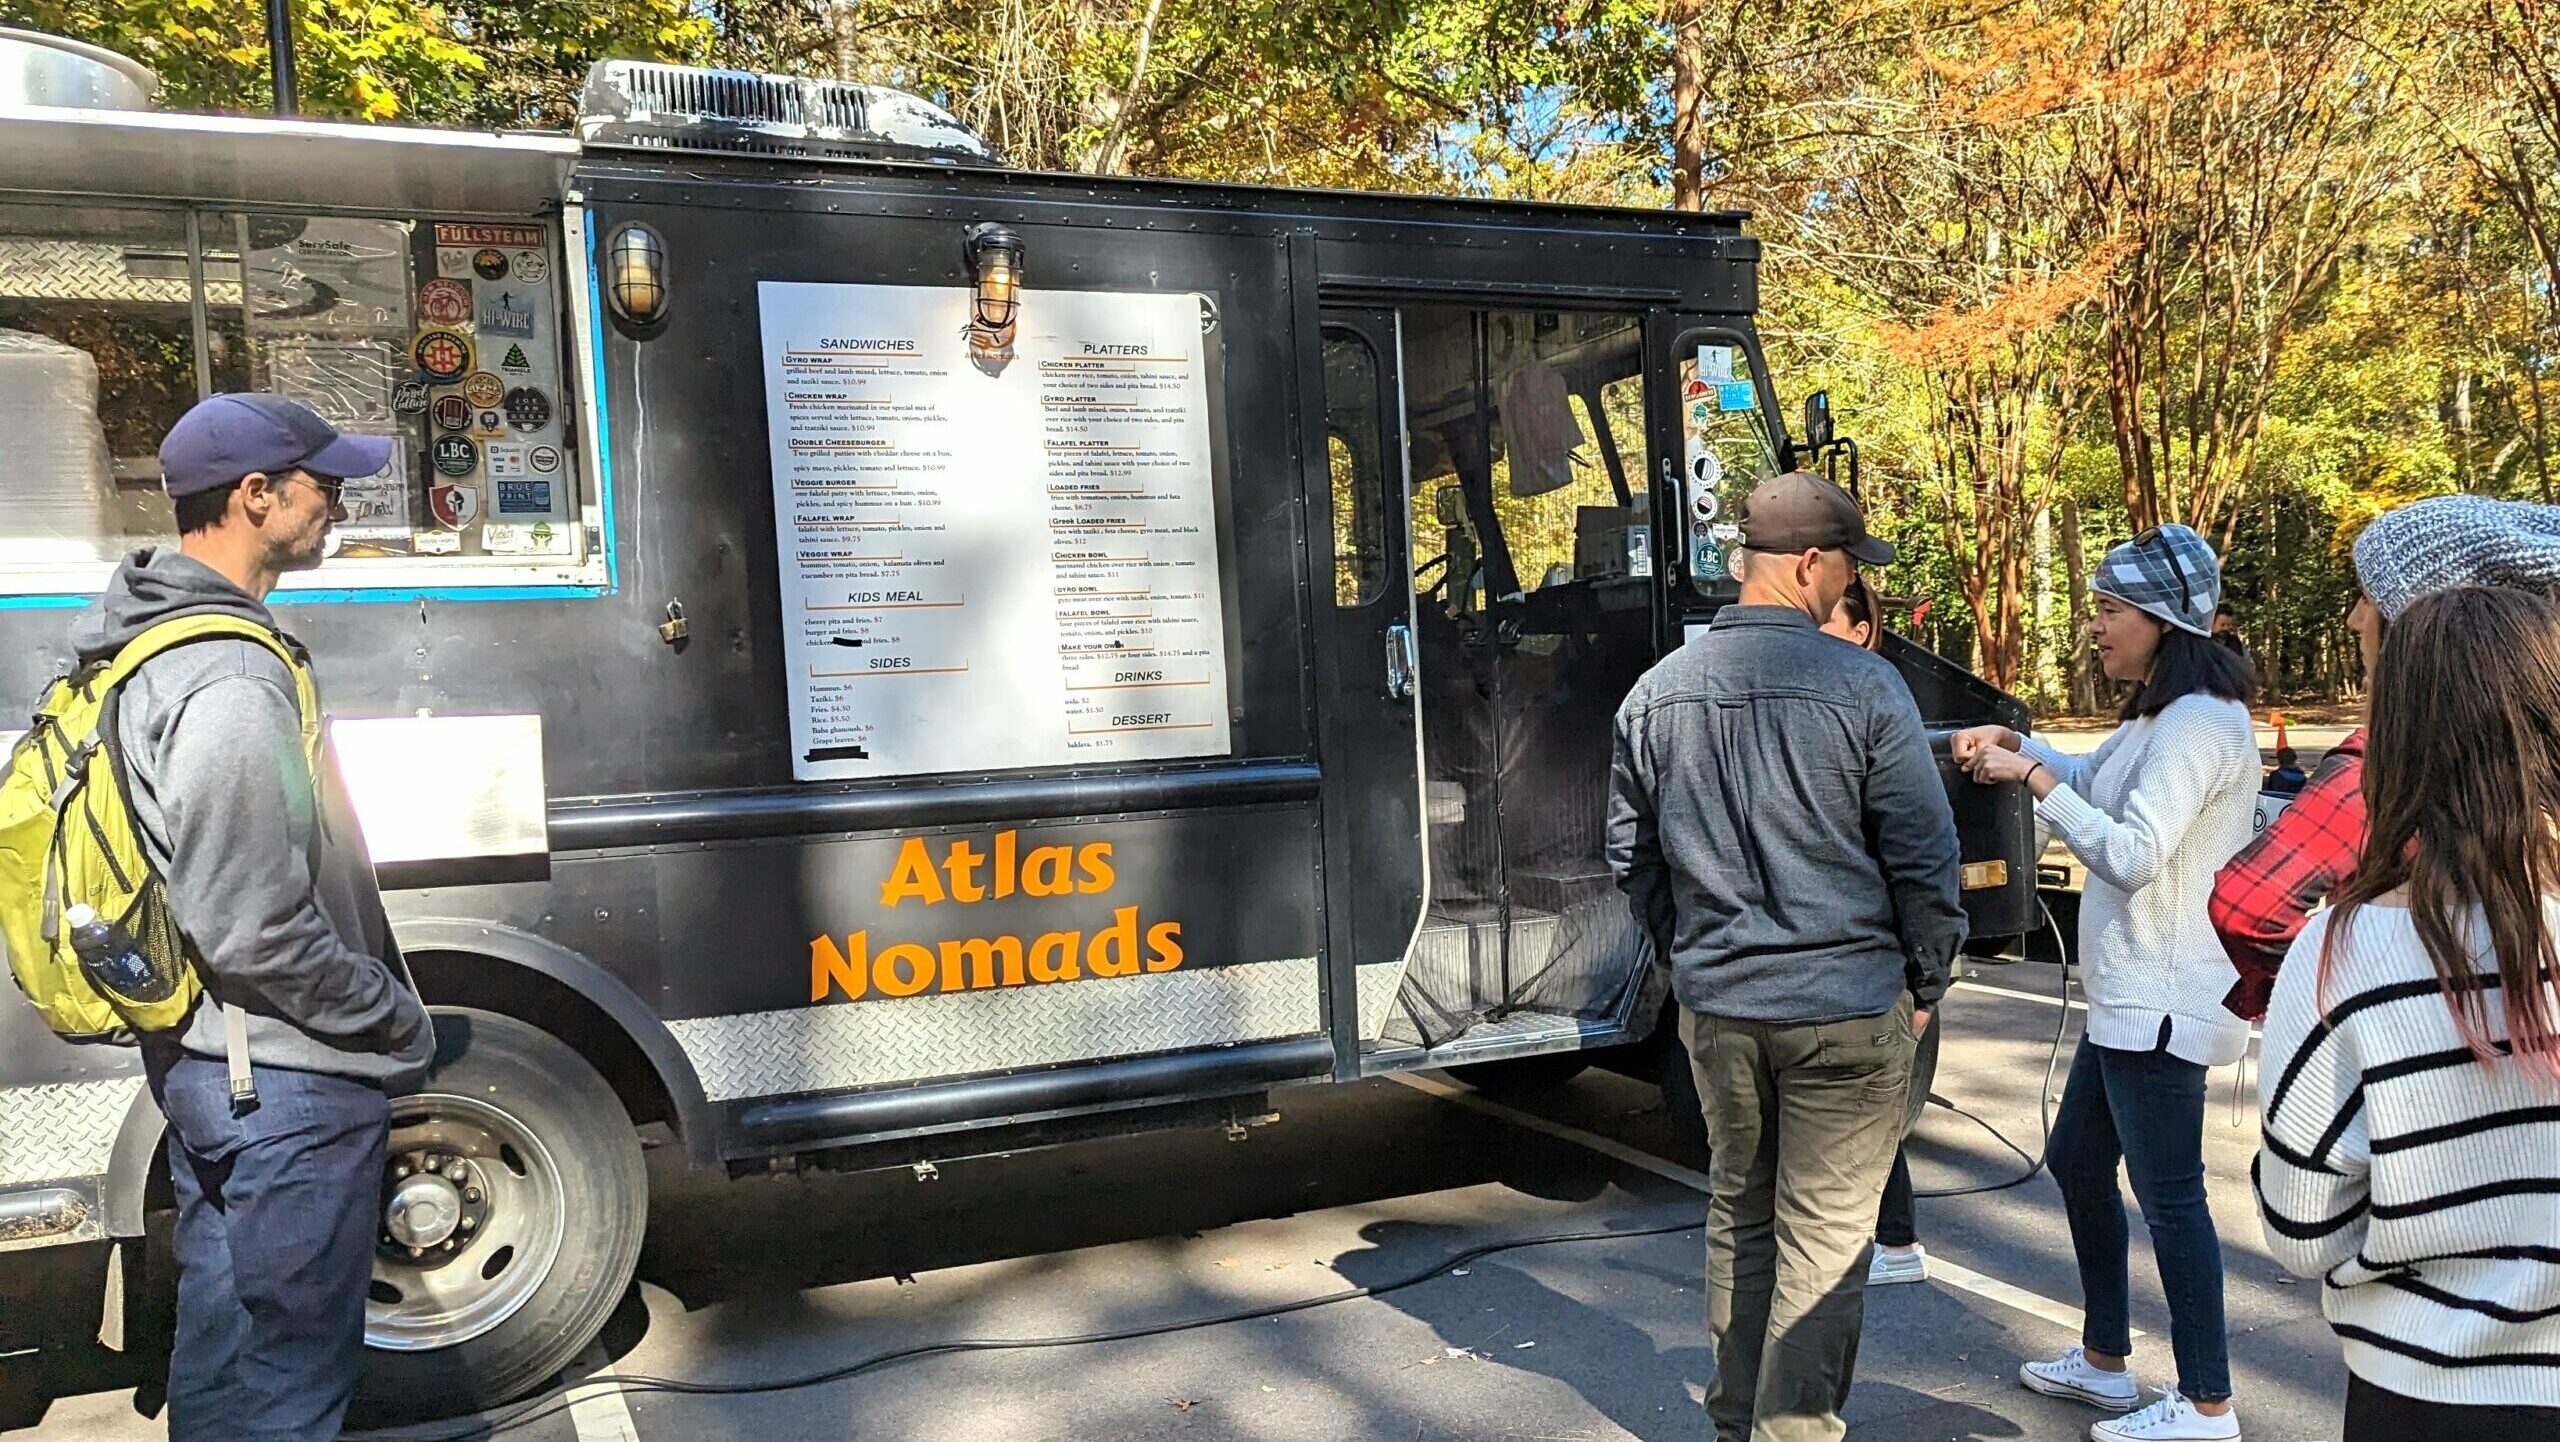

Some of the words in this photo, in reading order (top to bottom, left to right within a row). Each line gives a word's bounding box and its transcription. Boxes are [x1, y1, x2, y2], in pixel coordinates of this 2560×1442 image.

[440, 228, 538, 244] FULLSTEAM
[299, 240, 351, 250] ServSafe
[484, 308, 530, 329] HI-WIRE
[820, 339, 914, 350] SANDWICHES
[1084, 344, 1148, 355] PLATTERS
[440, 442, 470, 458] LBC
[1701, 551, 1718, 563] LBC
[848, 592, 881, 603] KIDS
[886, 591, 924, 602] MEAL
[870, 657, 911, 669] SIDES
[1115, 671, 1162, 682] DRINKS
[1113, 714, 1171, 726] DESSERT
[880, 830, 1116, 908] Atlas
[810, 905, 1184, 1003] Nomads
